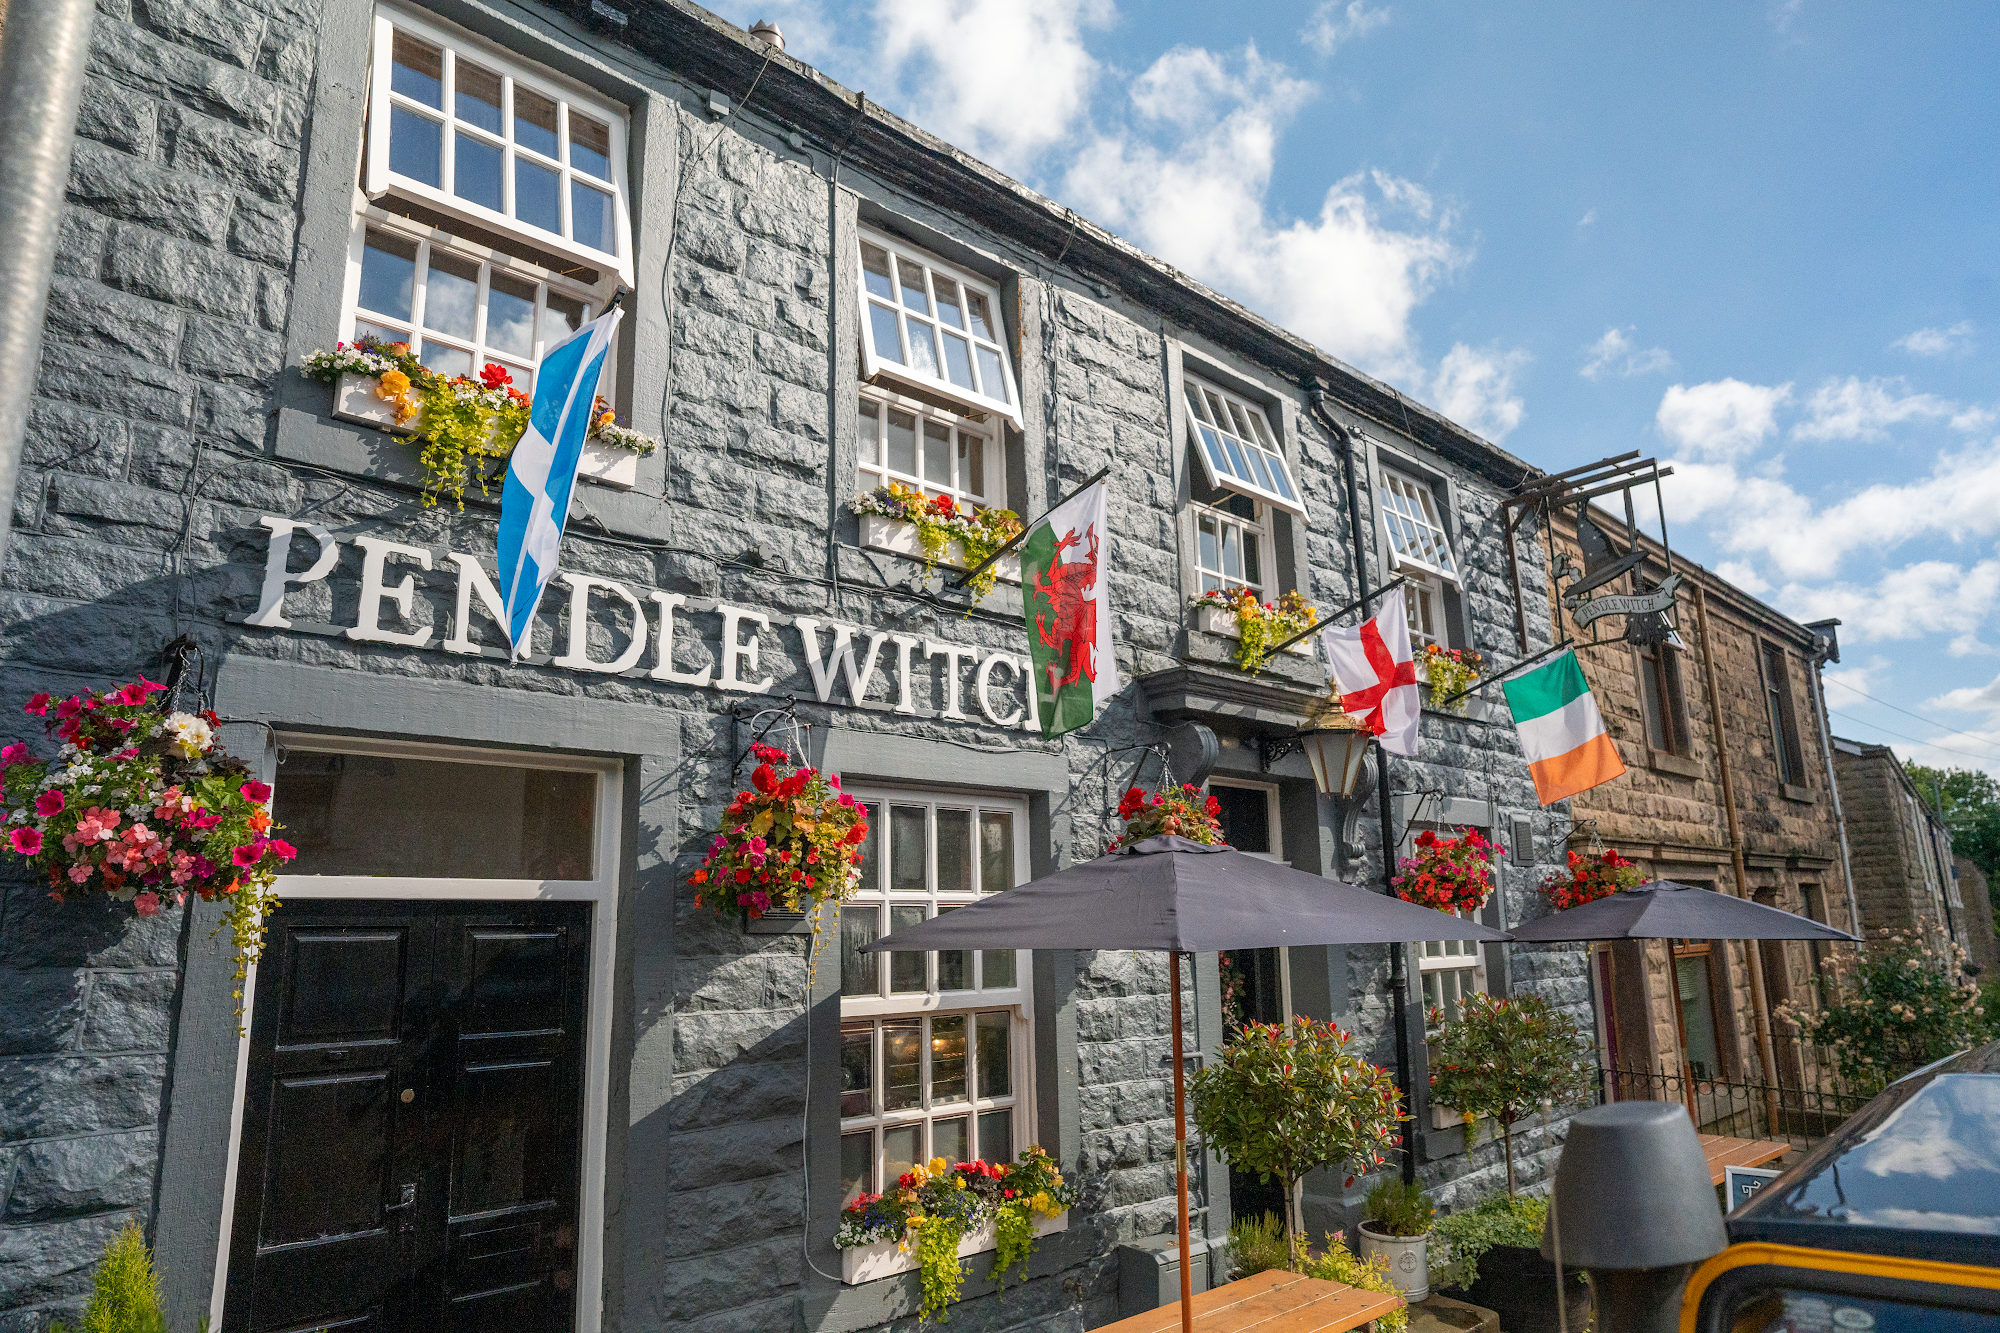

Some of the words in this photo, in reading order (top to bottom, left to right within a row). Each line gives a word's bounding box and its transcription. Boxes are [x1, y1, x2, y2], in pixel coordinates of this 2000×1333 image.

[244, 516, 773, 693] PENDLE
[1582, 598, 1620, 619] PENDLE
[1619, 598, 1655, 611] WITCH
